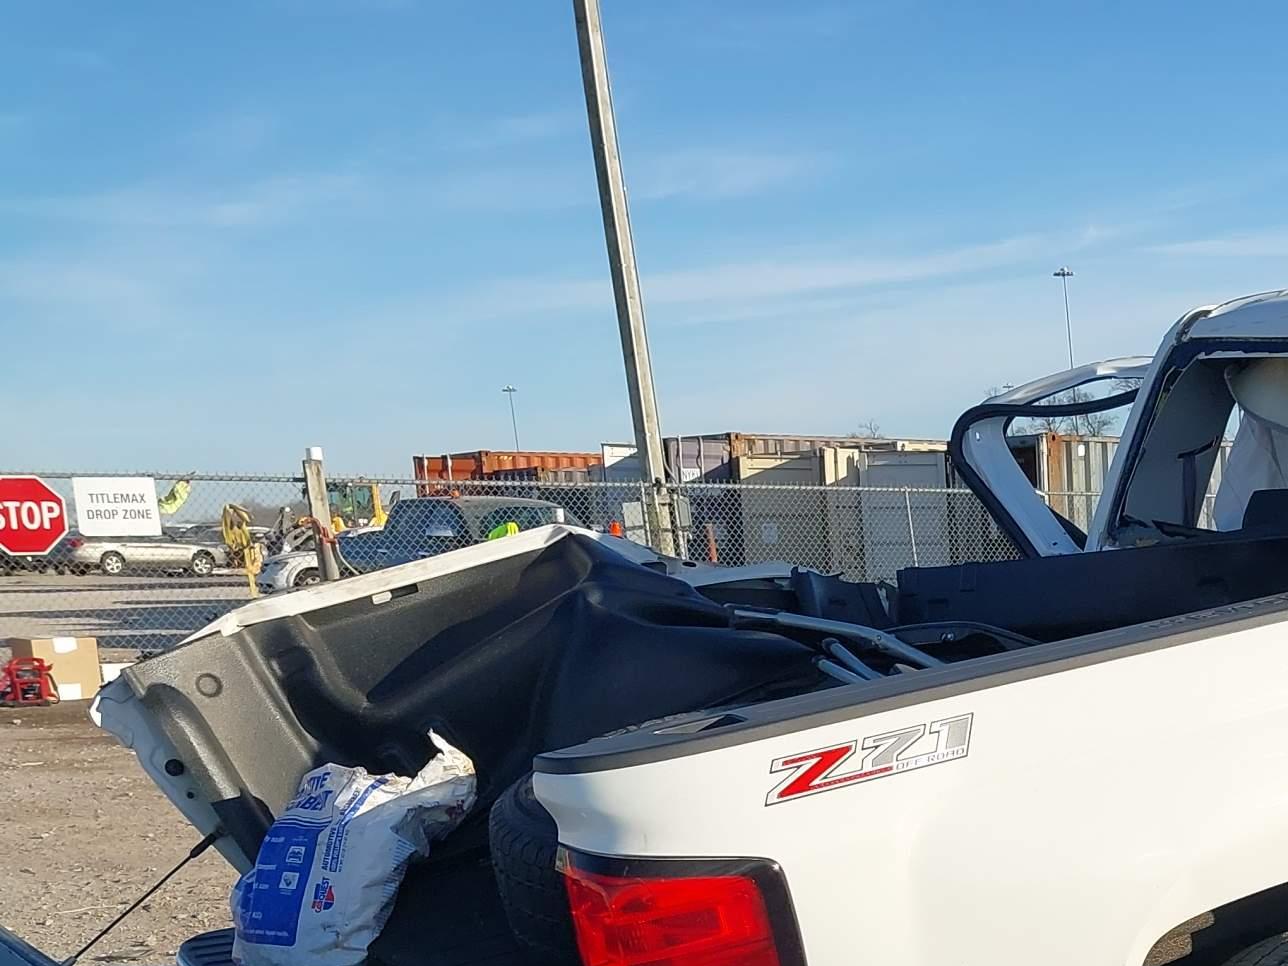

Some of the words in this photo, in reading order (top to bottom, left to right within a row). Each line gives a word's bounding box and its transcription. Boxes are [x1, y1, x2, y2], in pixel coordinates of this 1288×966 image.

[88, 493, 146, 504] TITLEMAX
[87, 509, 118, 520] DROP
[123, 509, 152, 520] ZONE
[764, 712, 974, 807] Z71
[928, 747, 965, 763] ROAD
